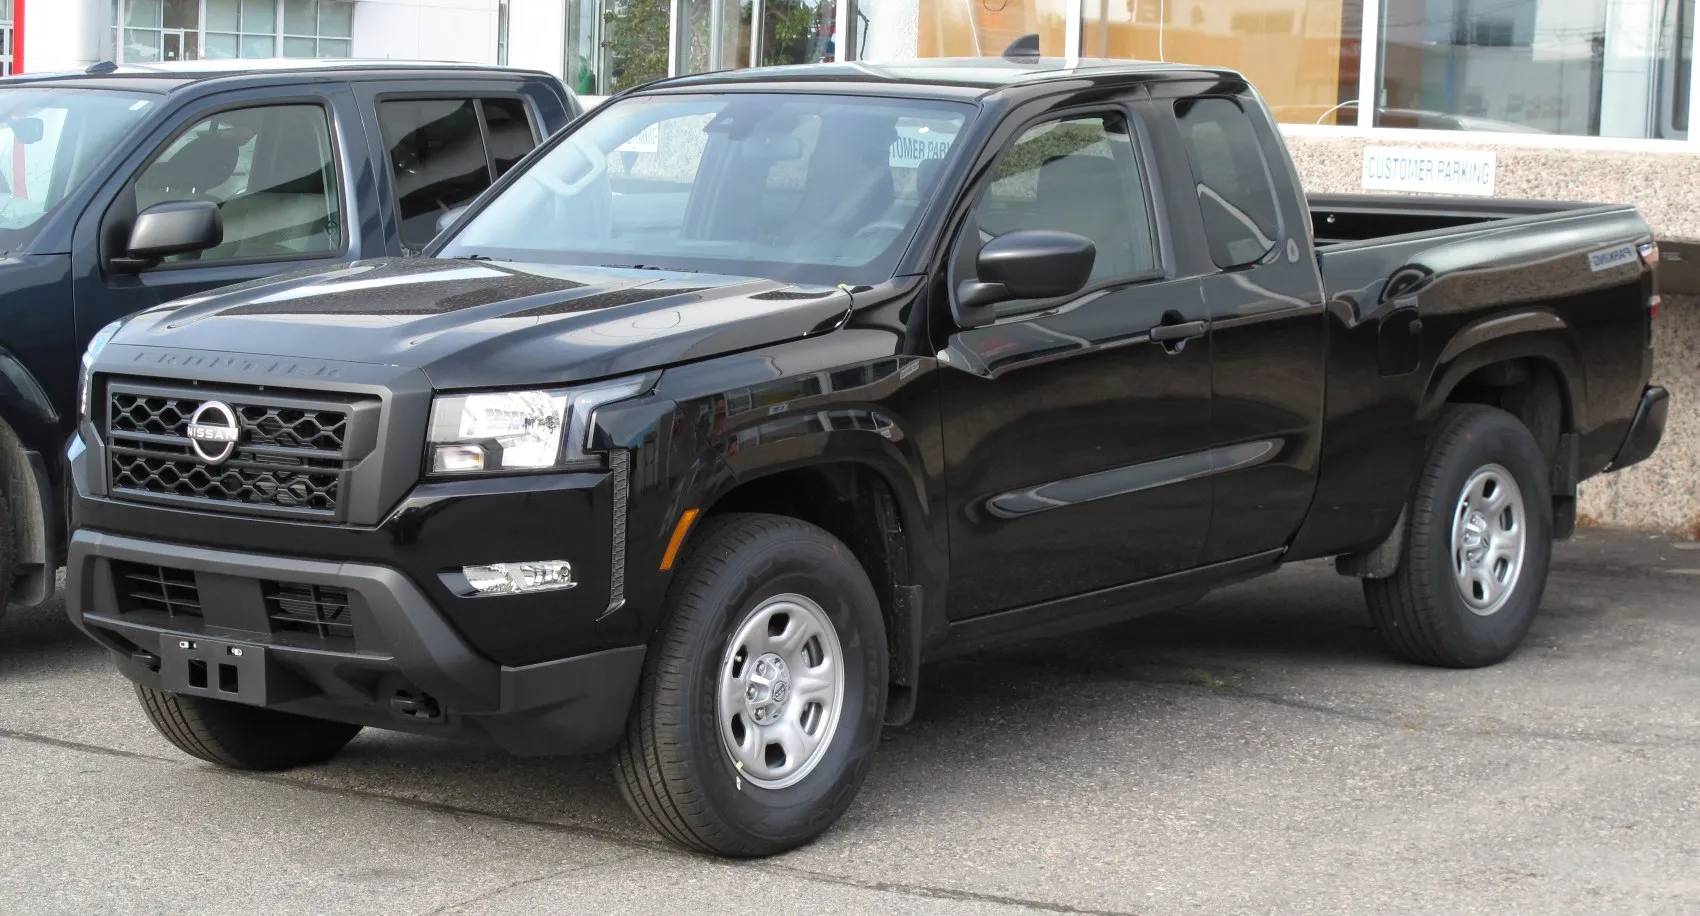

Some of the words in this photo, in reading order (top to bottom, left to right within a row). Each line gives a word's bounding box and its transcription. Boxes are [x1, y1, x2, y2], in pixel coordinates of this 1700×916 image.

[1368, 156, 1433, 181] CUSTOMER
[1438, 160, 1490, 184] PARKING
[133, 351, 341, 378] FRONTIER
[186, 425, 239, 441] NISSAN
